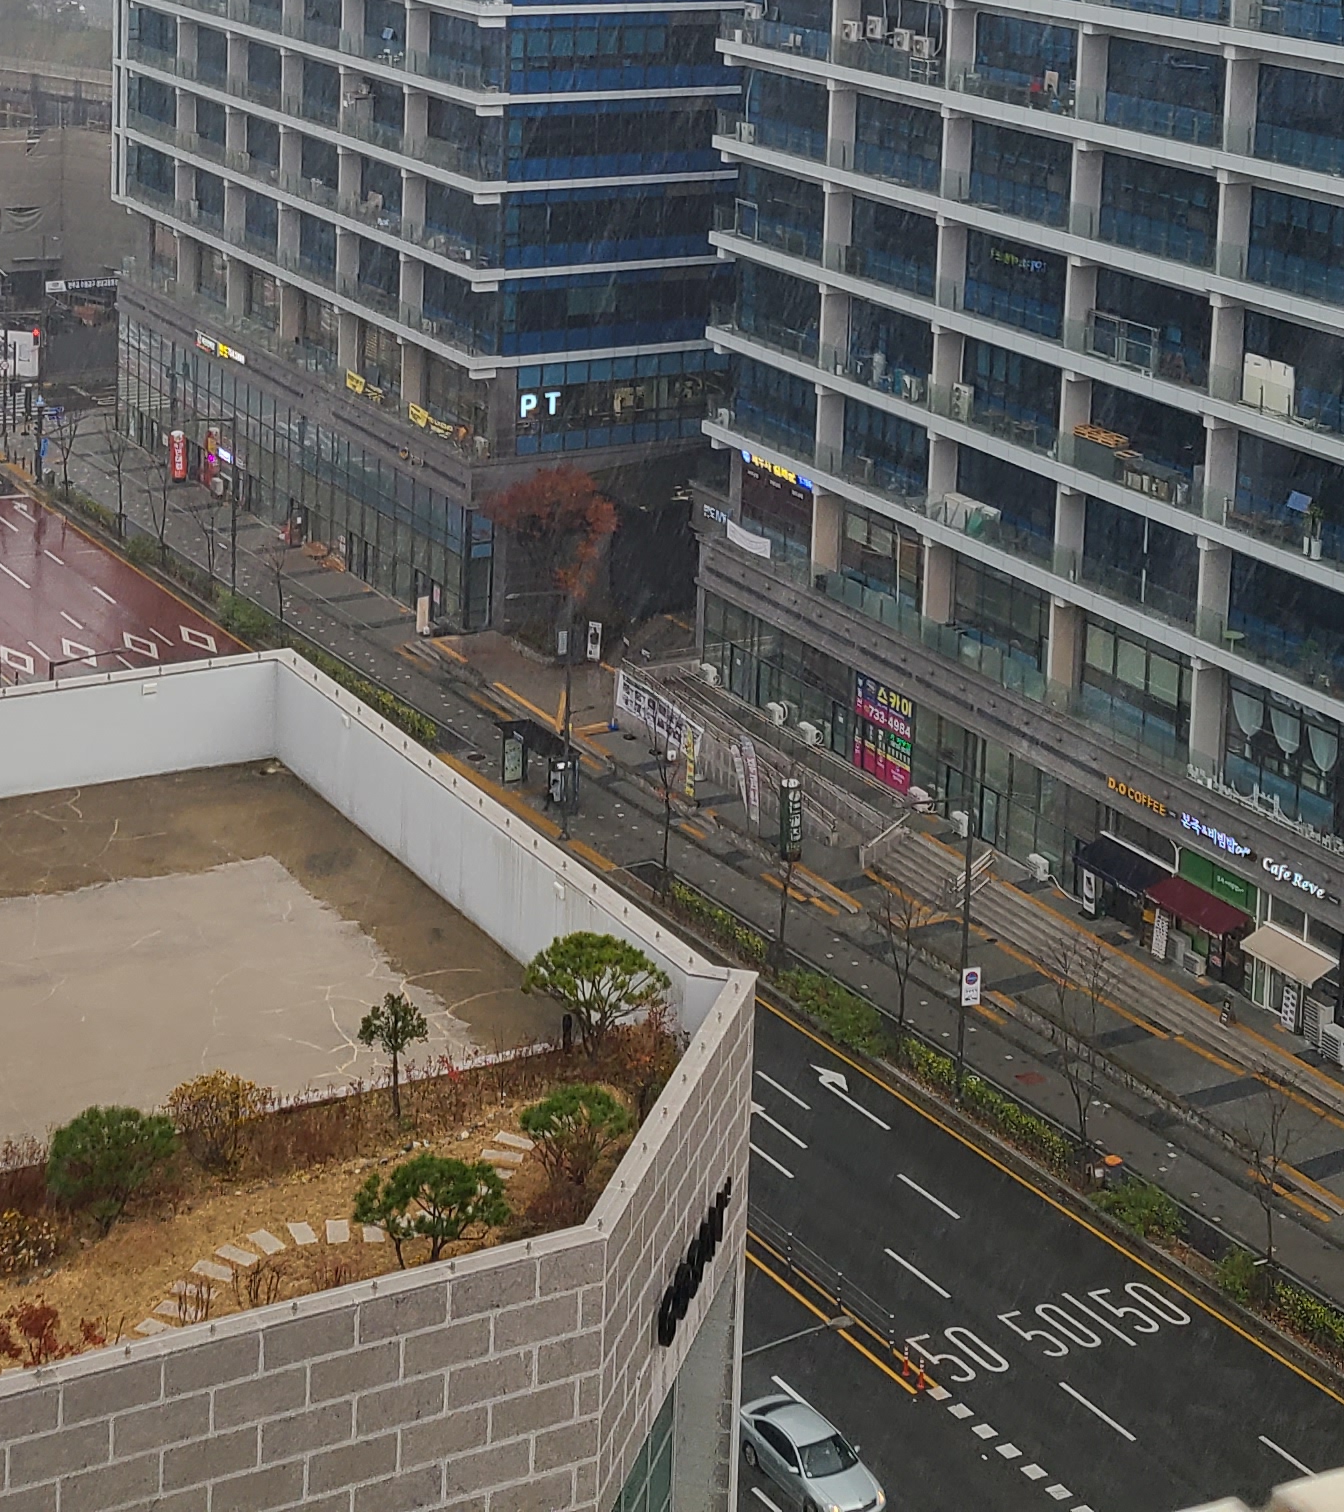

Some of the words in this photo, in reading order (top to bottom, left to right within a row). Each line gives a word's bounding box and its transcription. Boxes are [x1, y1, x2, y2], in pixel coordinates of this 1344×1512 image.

[520, 392, 561, 418] PT
[877, 687, 913, 718] 스카이
[1108, 776, 1126, 795] D.O
[1127, 788, 1167, 817] COFFEE
[1262, 857, 1292, 881] Cafe
[1291, 872, 1326, 899] Reve
[905, 1326, 1010, 1382] 50
[997, 1303, 1102, 1357] 50
[1087, 1282, 1192, 1333] 50
